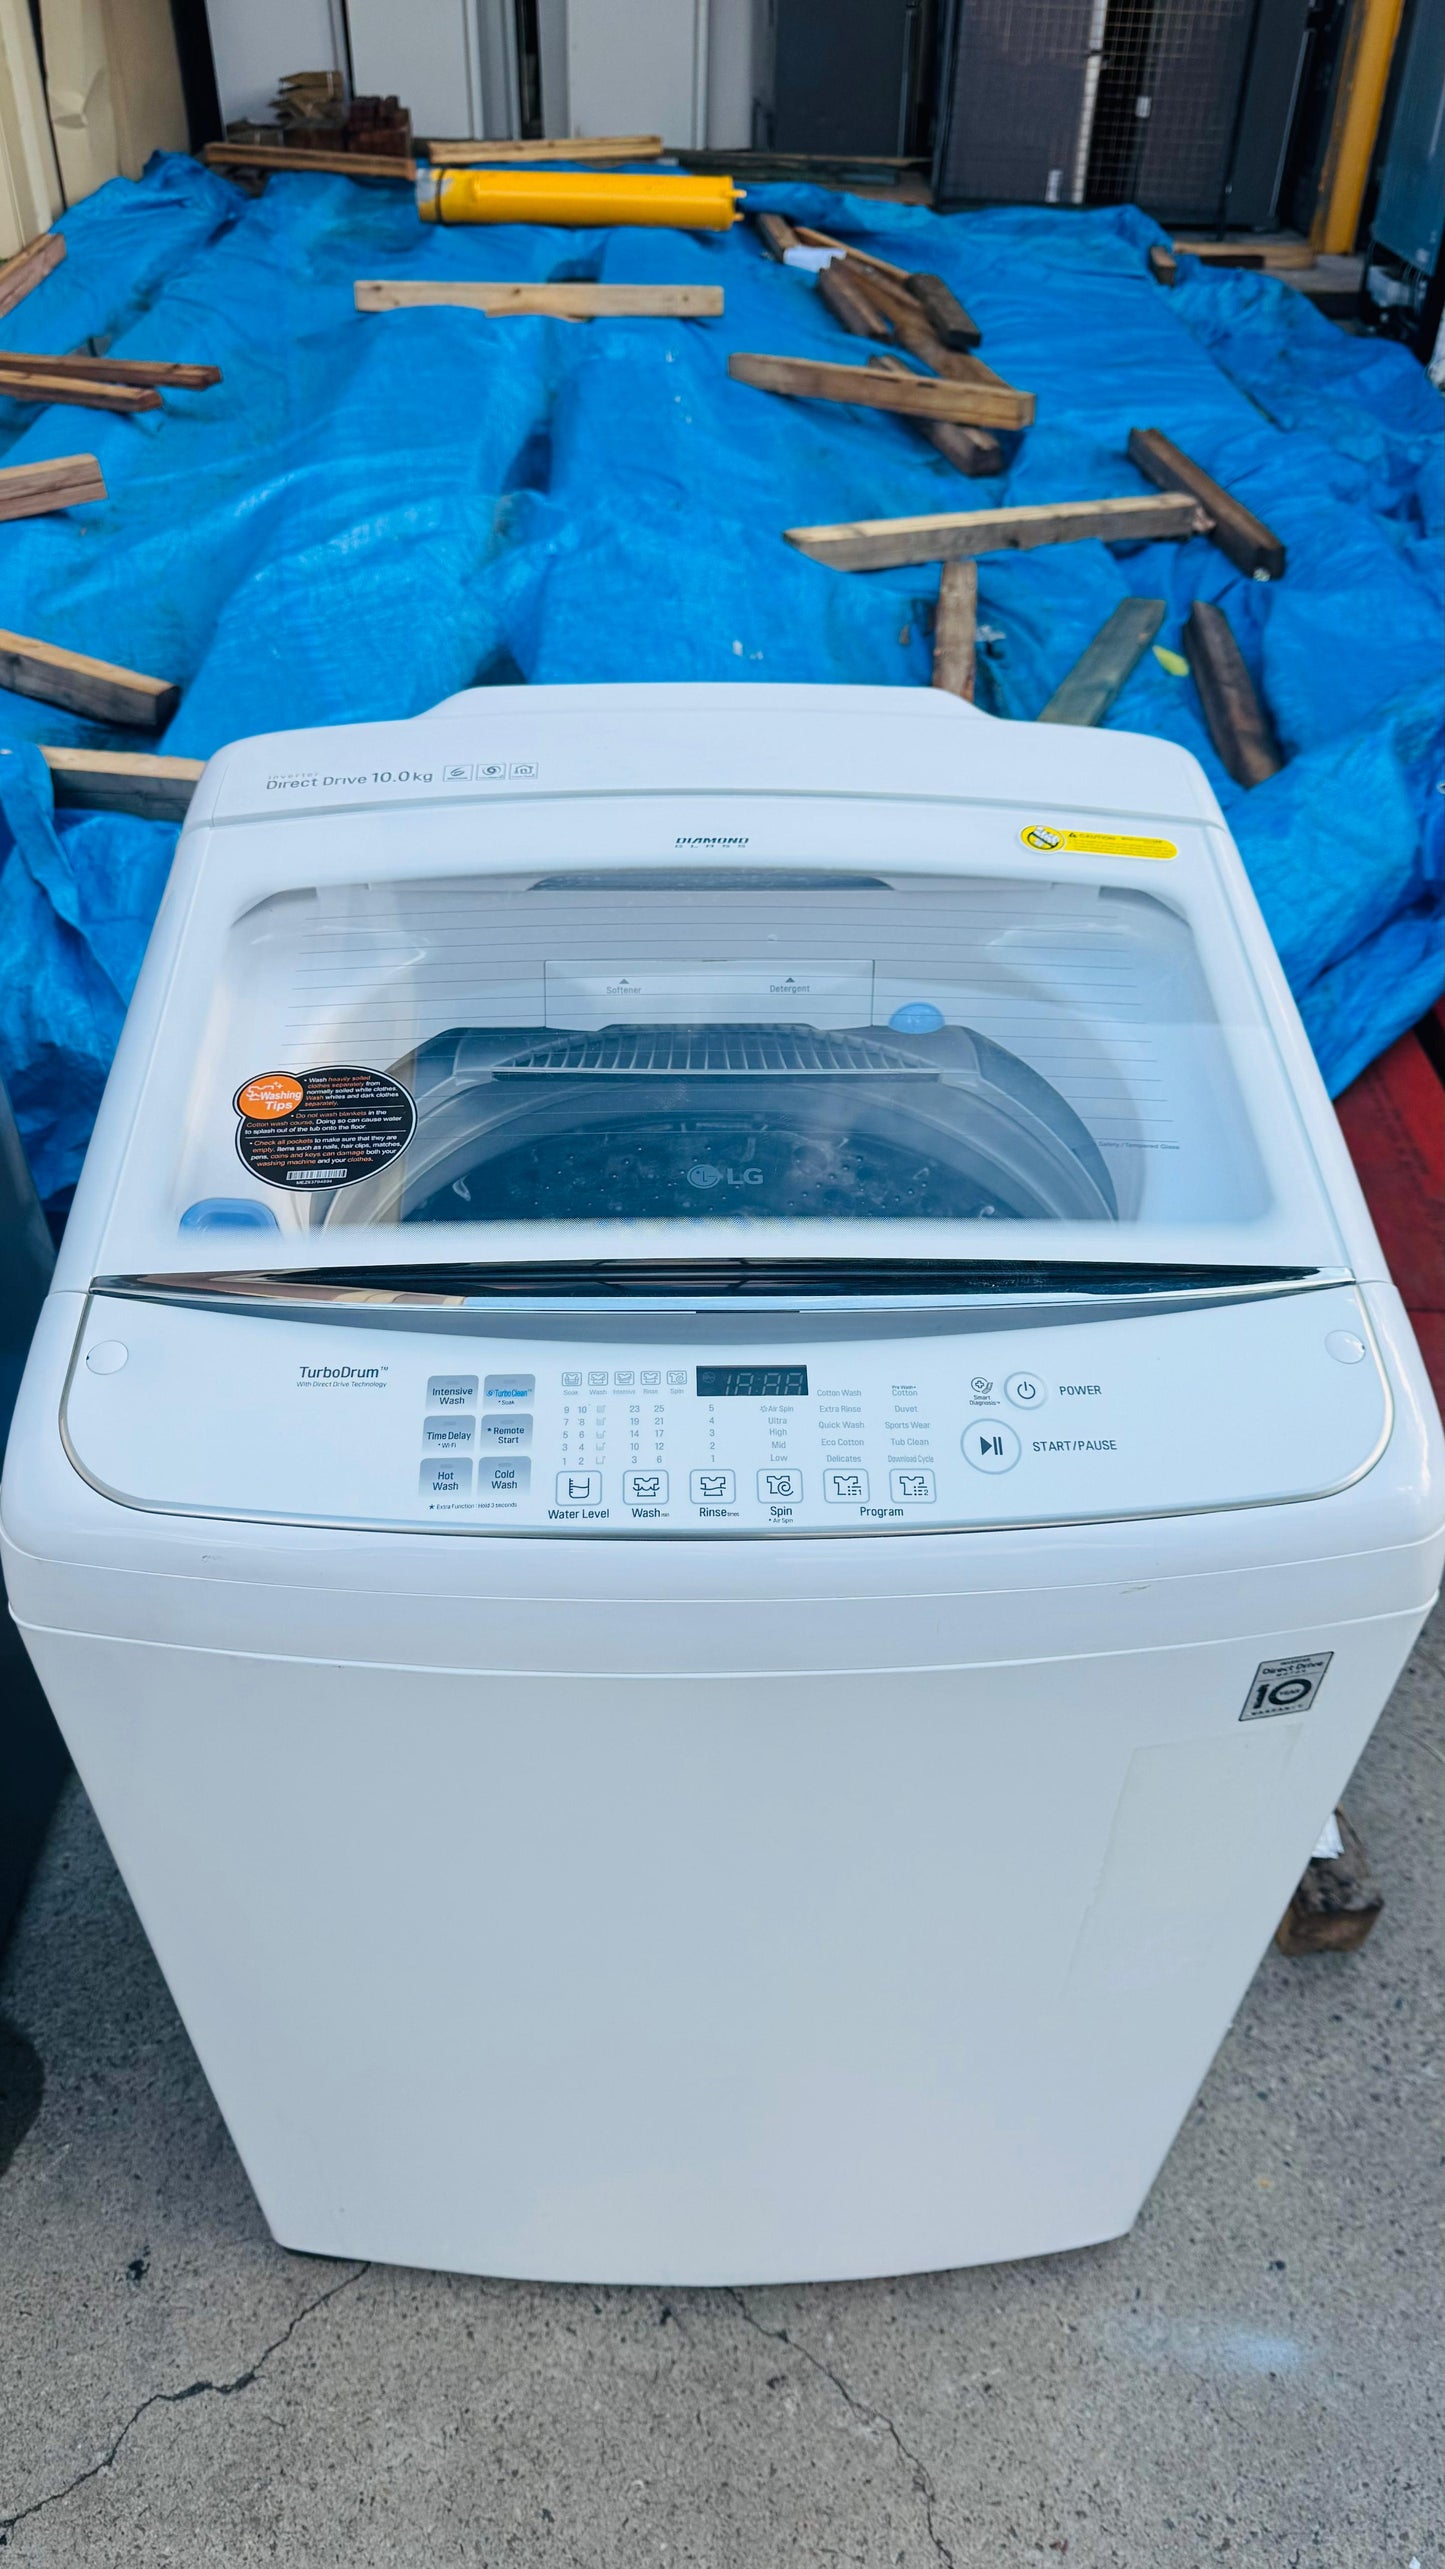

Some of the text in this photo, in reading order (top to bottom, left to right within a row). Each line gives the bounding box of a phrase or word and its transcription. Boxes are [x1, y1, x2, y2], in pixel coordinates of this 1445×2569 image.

[266, 778, 318, 790] Direct
[322, 775, 367, 786] Drive
[606, 986, 642, 994] Softener
[770, 984, 810, 994] Detergent
[260, 1090, 302, 1100] Washing
[265, 1101, 292, 1112] Tips
[727, 1168, 763, 1184] LG
[432, 1388, 473, 1396] Intensive
[1060, 1385, 1102, 1395] POWER
[578, 1406, 587, 1414] 10
[493, 1426, 524, 1435] Remote
[885, 1421, 909, 1430] Sports
[427, 1431, 471, 1441] Time Delay
[769, 1428, 787, 1436] High
[498, 1436, 519, 1444] Start
[1032, 1440, 1117, 1452] START/PAUSE
[632, 1456, 638, 1464] 3
[918, 1455, 934, 1463] Cycle
[438, 1472, 454, 1480] Hot
[494, 1470, 515, 1479] Cold
[432, 1482, 459, 1491] Wash
[491, 1481, 518, 1490] Wash
[548, 1508, 610, 1519] Water Level
[632, 1508, 660, 1518] Wash
[700, 1507, 727, 1517] Rinse
[770, 1506, 792, 1518] Spin
[860, 1507, 904, 1518] Program
[1262, 1661, 1323, 1674] Direct Drive
[1253, 1678, 1312, 1709] 10
